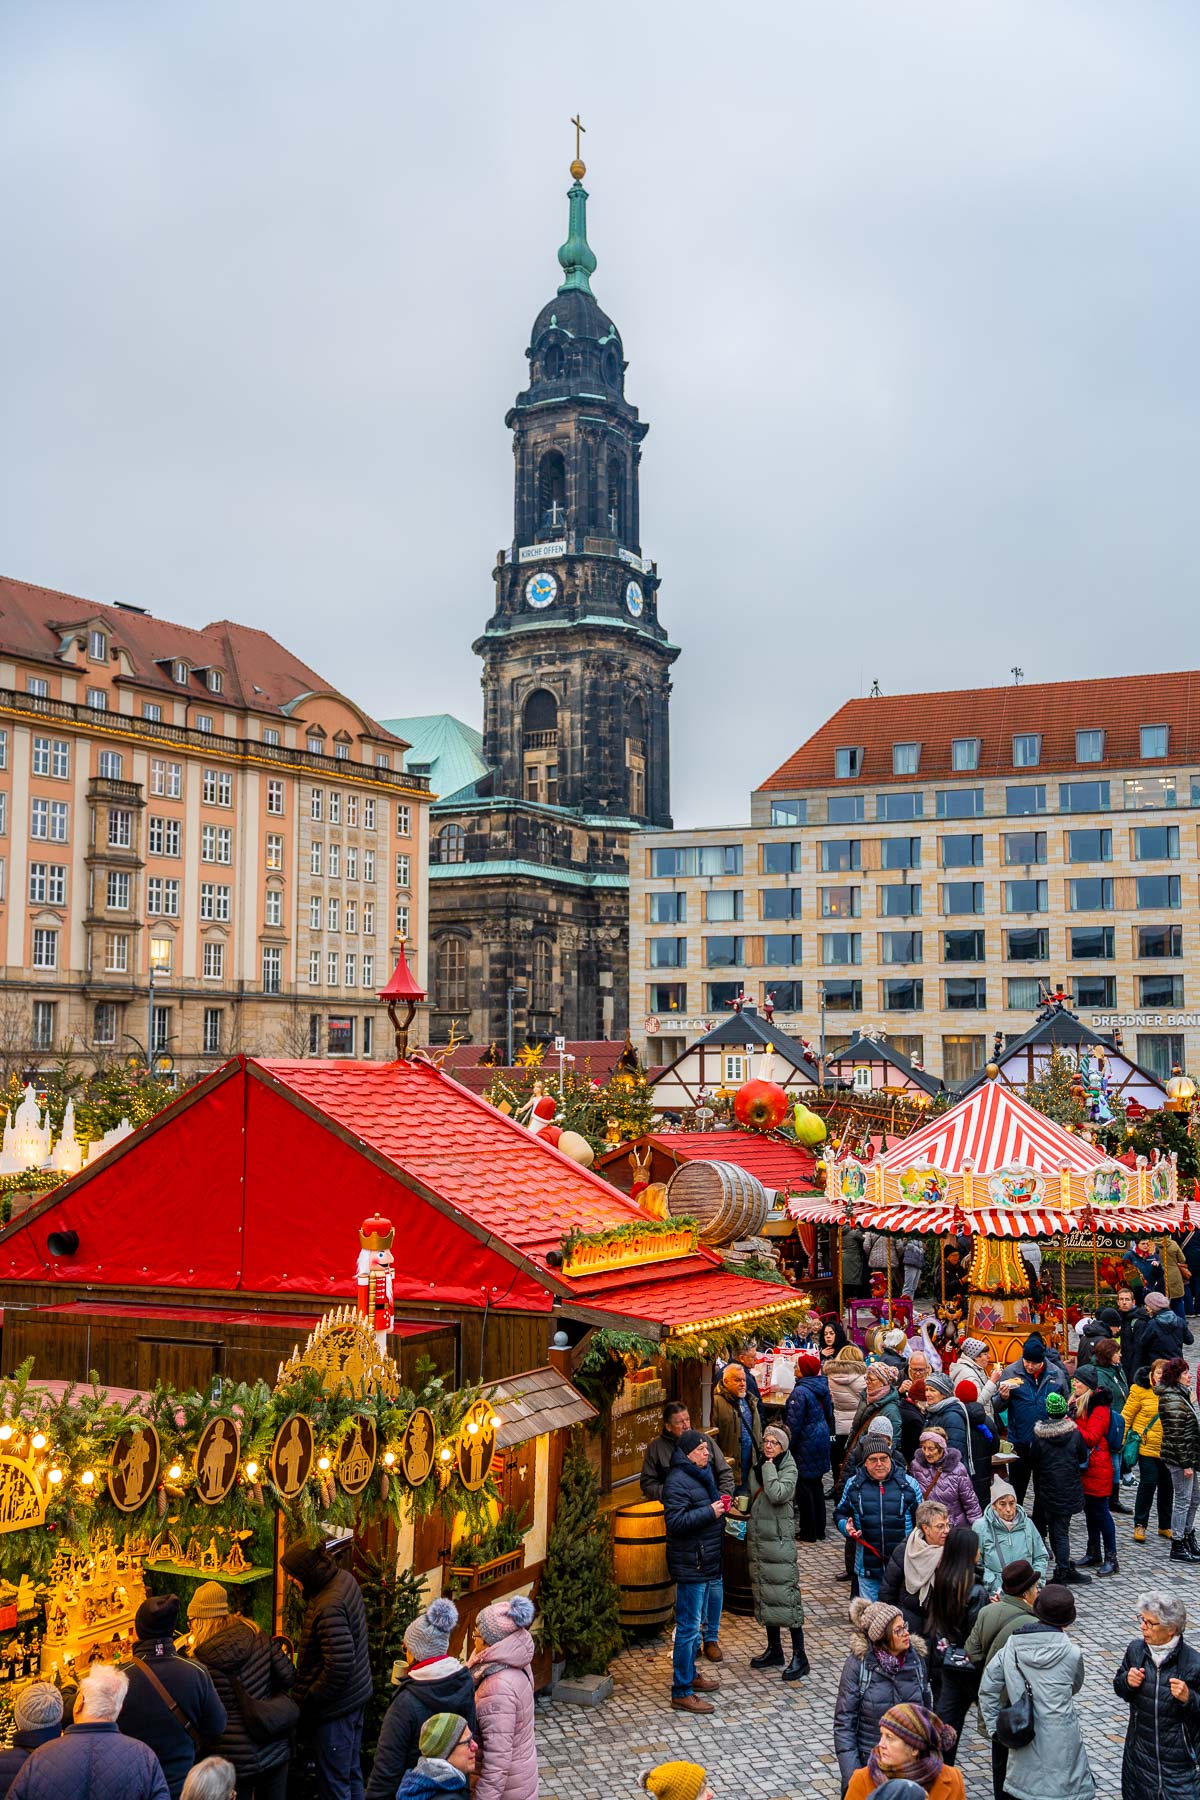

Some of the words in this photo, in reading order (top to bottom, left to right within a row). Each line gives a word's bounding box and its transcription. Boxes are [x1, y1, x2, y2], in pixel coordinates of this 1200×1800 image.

[522, 548, 542, 557] KIRCHE
[543, 545, 564, 555] OFFEN
[1092, 1015, 1162, 1027] DRESDNER
